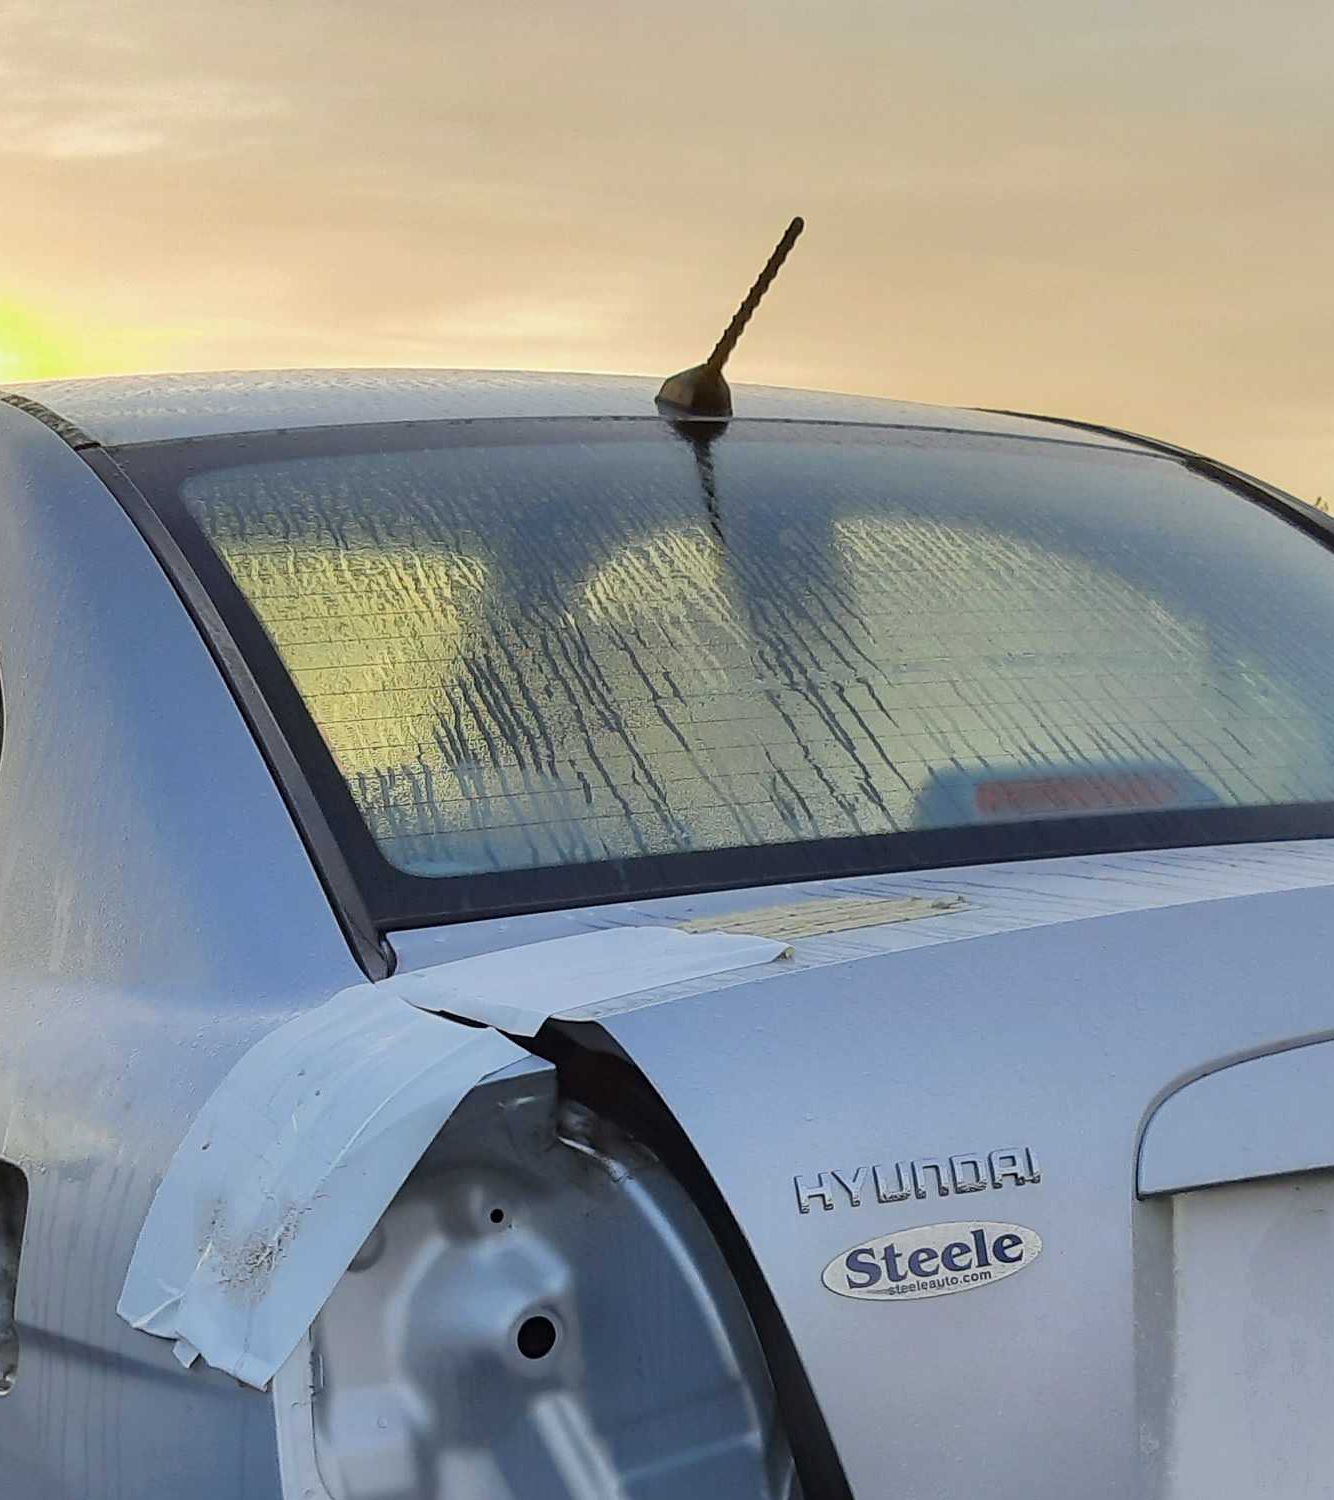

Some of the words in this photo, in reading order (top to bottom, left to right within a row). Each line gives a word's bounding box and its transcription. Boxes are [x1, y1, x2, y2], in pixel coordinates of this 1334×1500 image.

[794, 1147, 1041, 1214] HYUNDAI
[845, 1229, 1024, 1289] Steele
[888, 1270, 992, 1296] steeleauto.com
